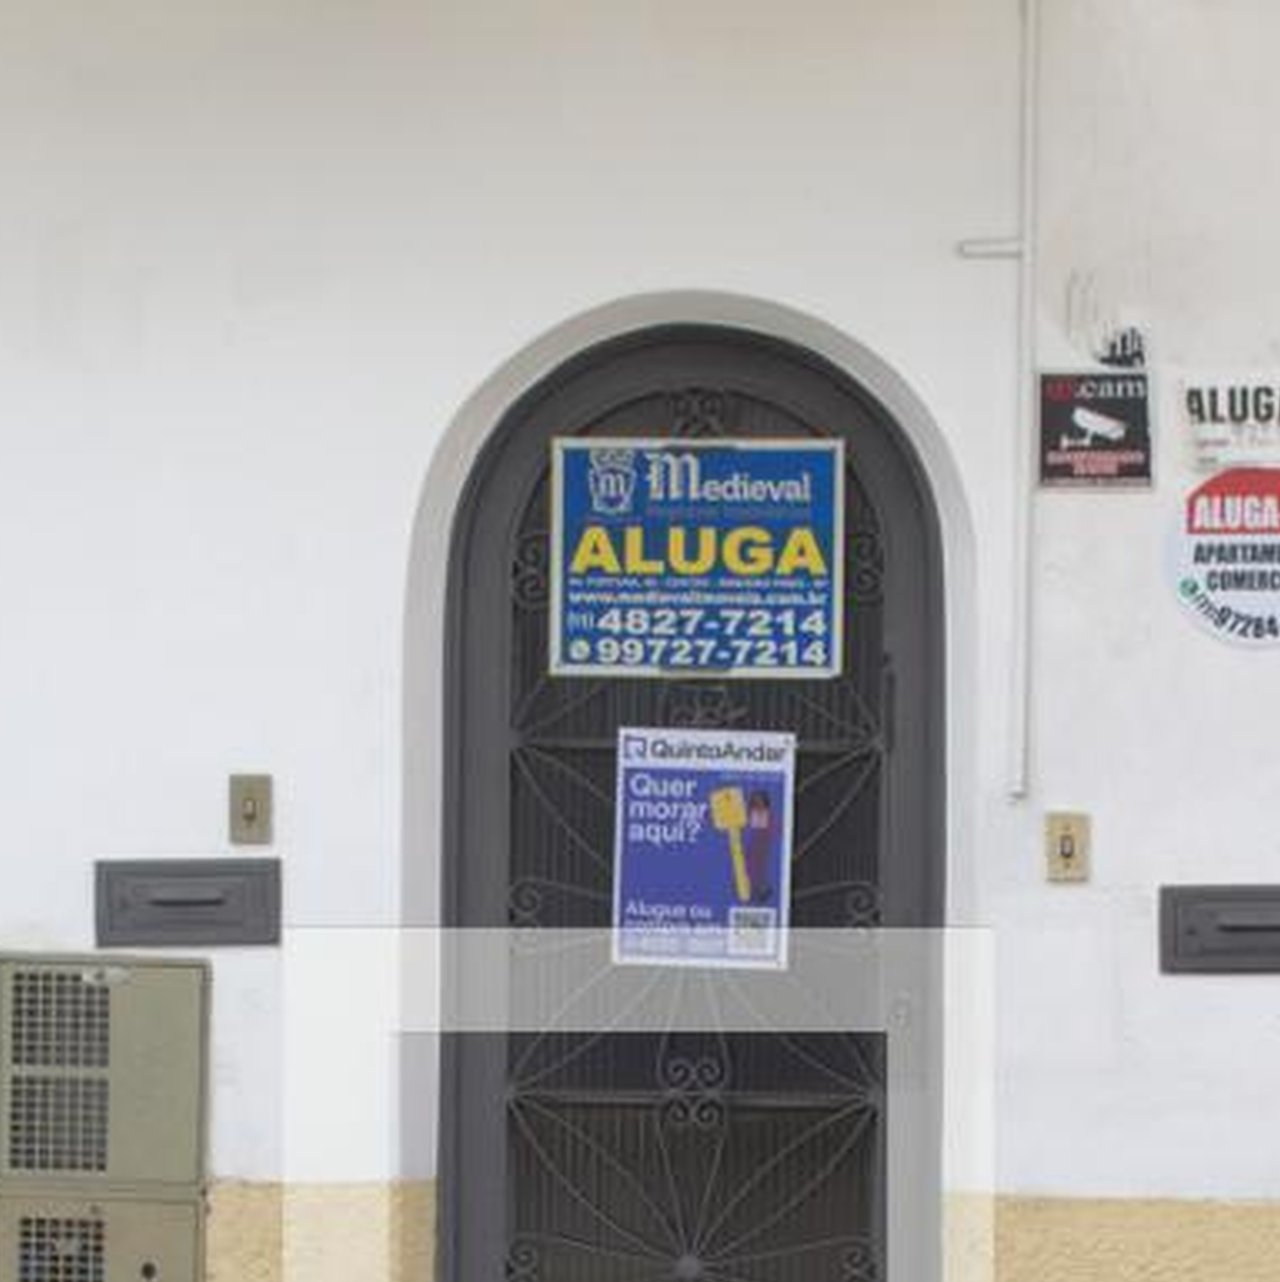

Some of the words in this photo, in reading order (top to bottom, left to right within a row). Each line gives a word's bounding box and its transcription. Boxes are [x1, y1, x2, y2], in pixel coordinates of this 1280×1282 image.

[643, 452, 811, 501] Medieval
[570, 525, 828, 576] ALUGA
[597, 609, 827, 636] 4827-7214
[597, 639, 827, 666] 99727-7214
[650, 739, 786, 762] QuintoAndar
[629, 772, 697, 798] Quer
[628, 802, 708, 821] morar
[627, 822, 701, 844] aqui?
